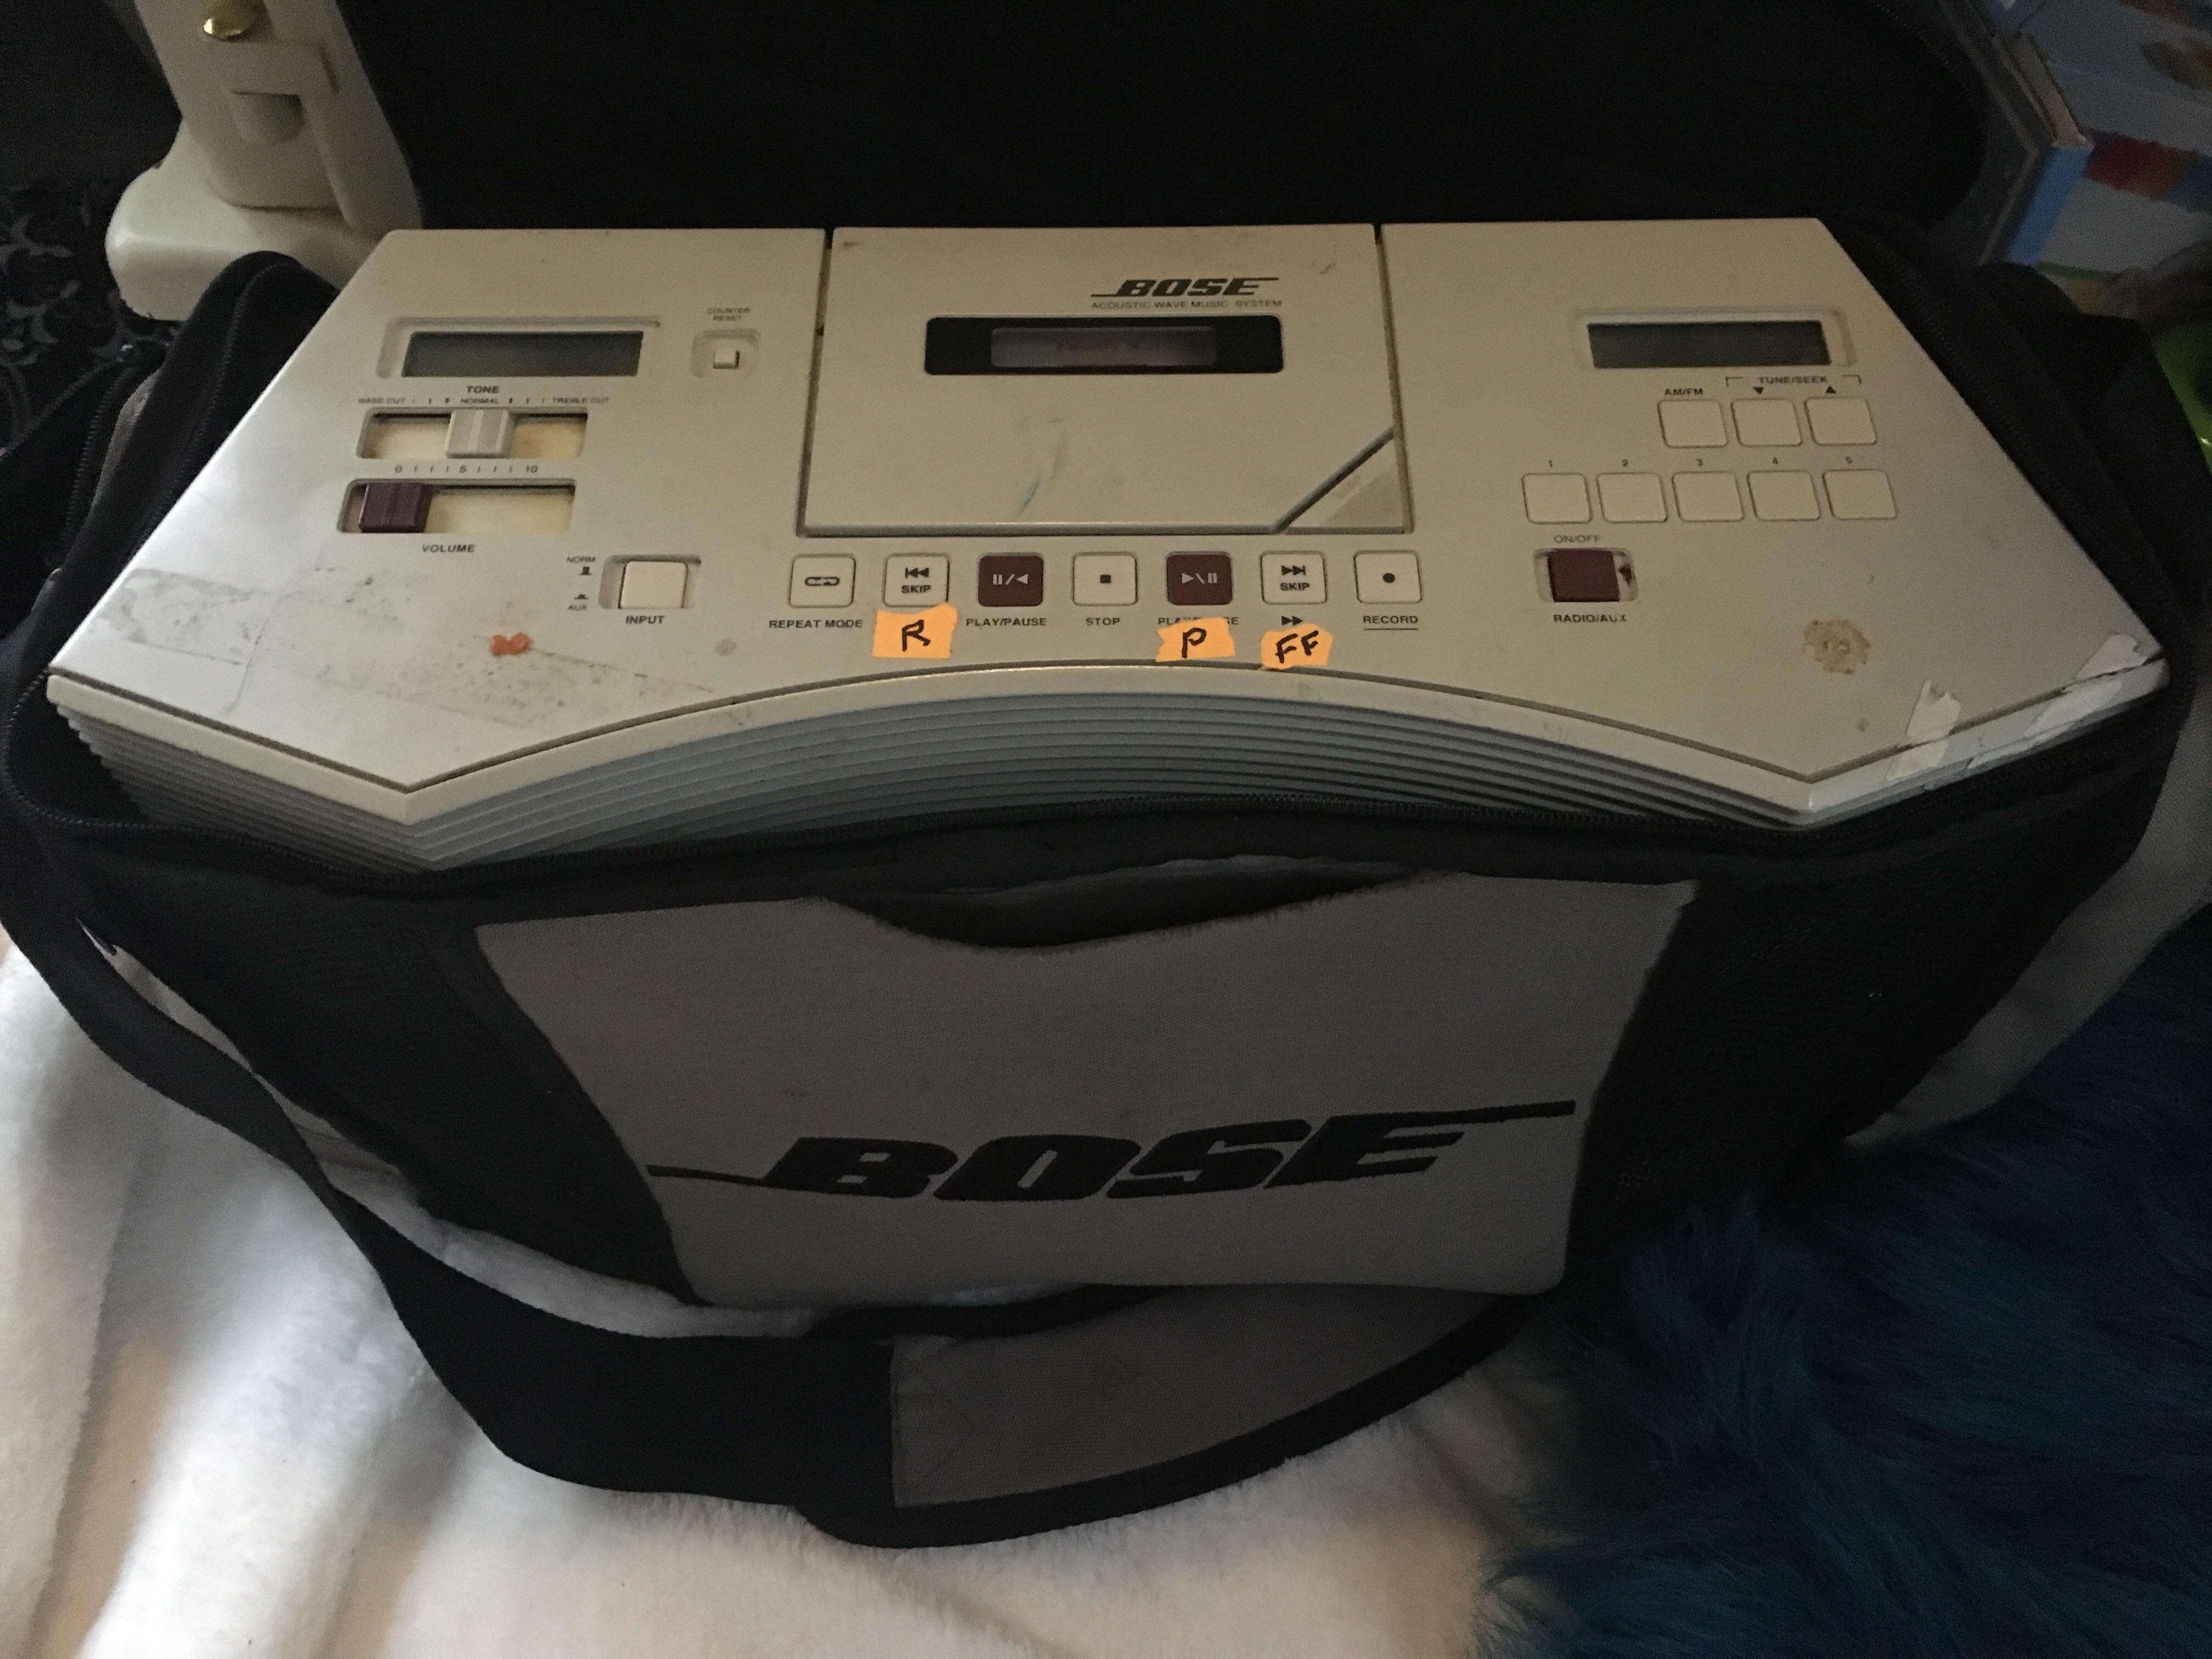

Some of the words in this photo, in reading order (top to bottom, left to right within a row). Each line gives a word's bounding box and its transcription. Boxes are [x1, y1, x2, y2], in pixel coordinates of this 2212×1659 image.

[1091, 278, 1279, 297] BOSE
[1759, 376, 1827, 384] TUNE/SEEK
[467, 386, 499, 394] TONE
[1554, 535, 1601, 543] ON/OFF
[422, 544, 475, 552] VOLUME
[901, 584, 930, 594] SKIP
[1280, 582, 1310, 591] SKIP
[625, 616, 664, 624] INPUT
[966, 618, 1047, 627] PLAY/PAUSE
[1086, 617, 1120, 625] STOP
[1363, 615, 1418, 624] RECORD
[1554, 614, 1627, 623] RADIO/AUX
[769, 619, 821, 628] REPEAT
[825, 619, 863, 628] MODE
[901, 619, 931, 652] R
[1182, 627, 1206, 658] P
[1275, 630, 1319, 664] FF
[646, 1099, 1576, 1201] BOSE
